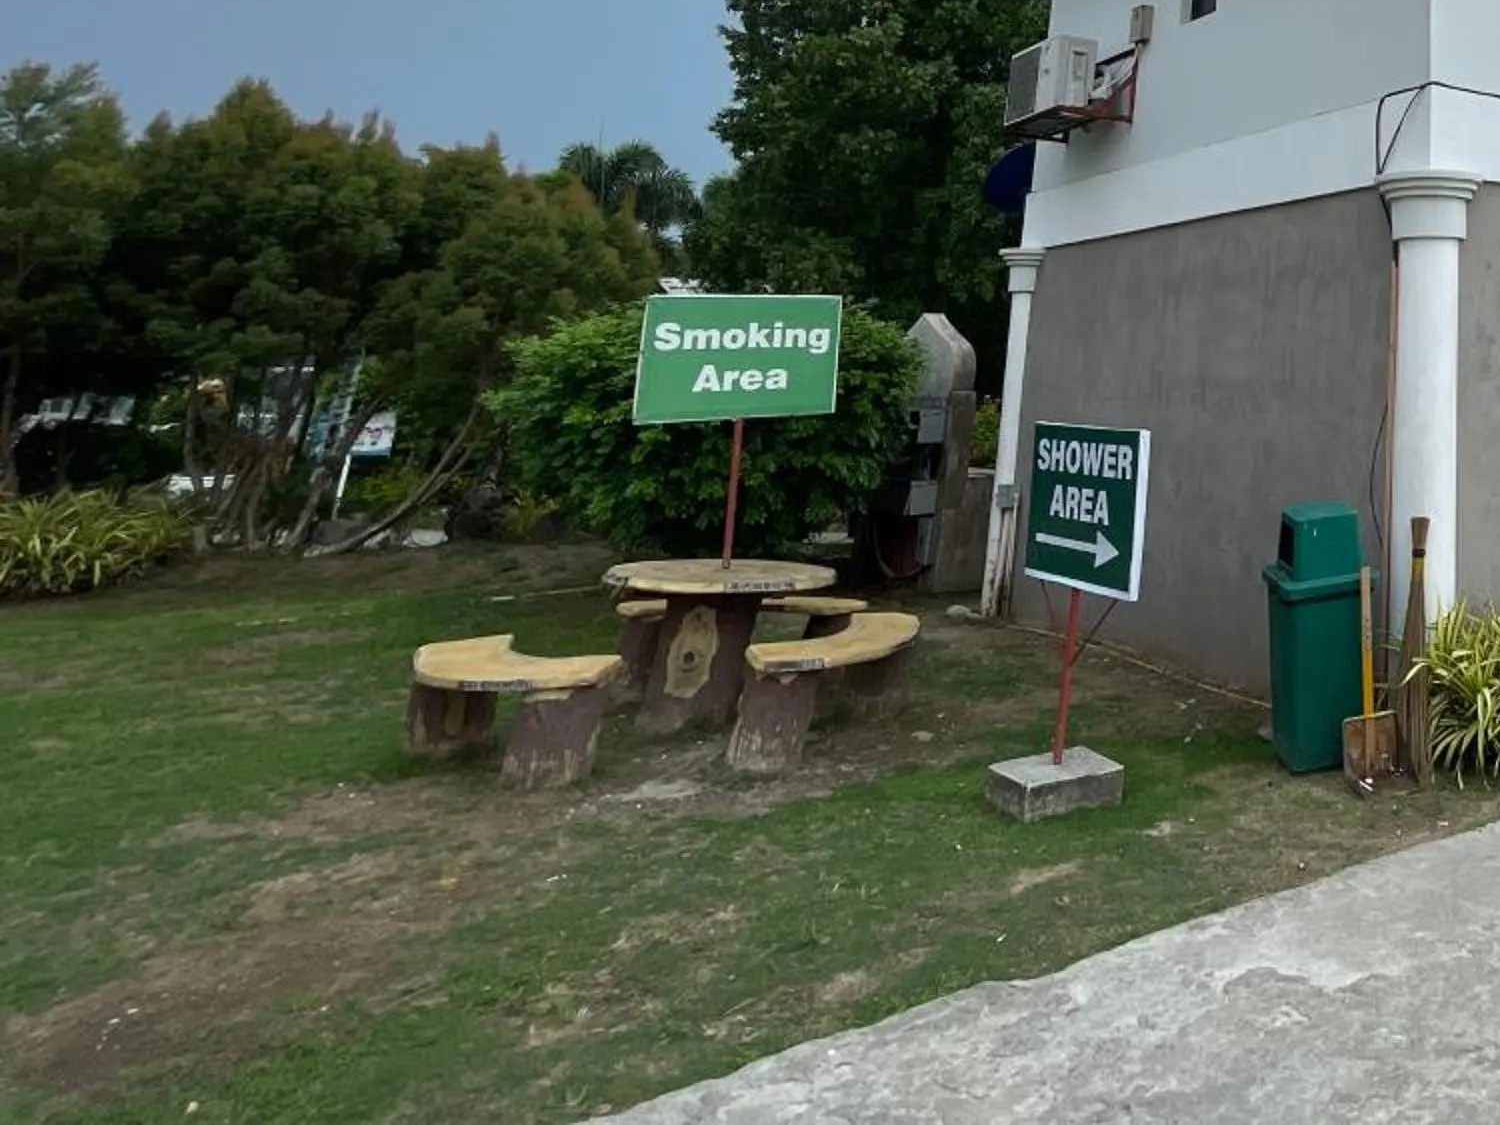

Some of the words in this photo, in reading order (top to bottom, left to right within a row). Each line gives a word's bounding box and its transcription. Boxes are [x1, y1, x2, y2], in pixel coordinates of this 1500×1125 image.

[653, 321, 832, 354] Smoking
[691, 364, 789, 393] Area
[1036, 438, 1134, 480] SHOWER
[1049, 484, 1110, 526] AREA
